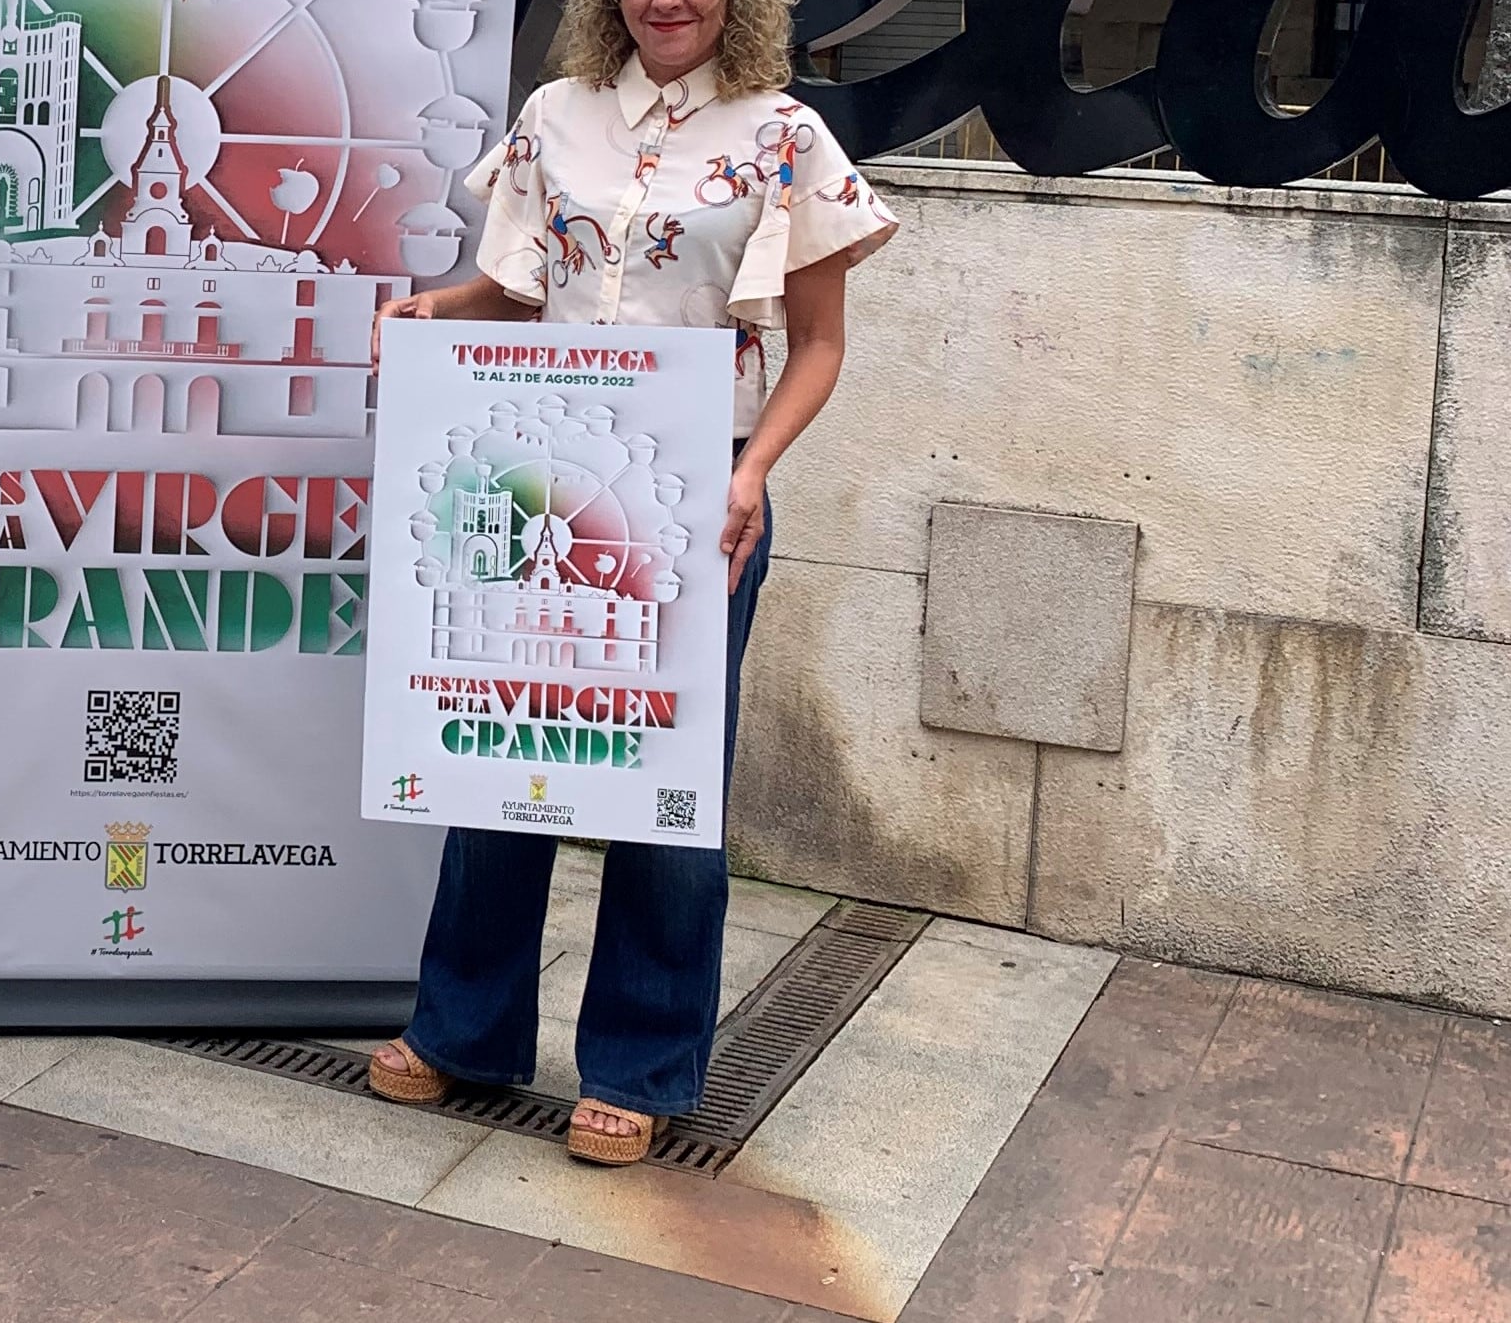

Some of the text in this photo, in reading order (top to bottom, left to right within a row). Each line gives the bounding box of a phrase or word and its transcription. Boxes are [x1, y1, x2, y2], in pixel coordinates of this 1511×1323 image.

[452, 344, 658, 372] TORRELAVEGA
[473, 370, 635, 387] 12 AL 21 DE AGOSTO 2022
[409, 675, 491, 695] FIESTAS
[437, 695, 491, 714] DE LA
[493, 680, 676, 729] VIRGEN
[441, 718, 642, 769] GRANDE
[501, 801, 575, 815] AYUNTAMIENTO
[501, 811, 574, 826] TORRELAVEGA
[154, 843, 337, 866] TORRELAVEGA
